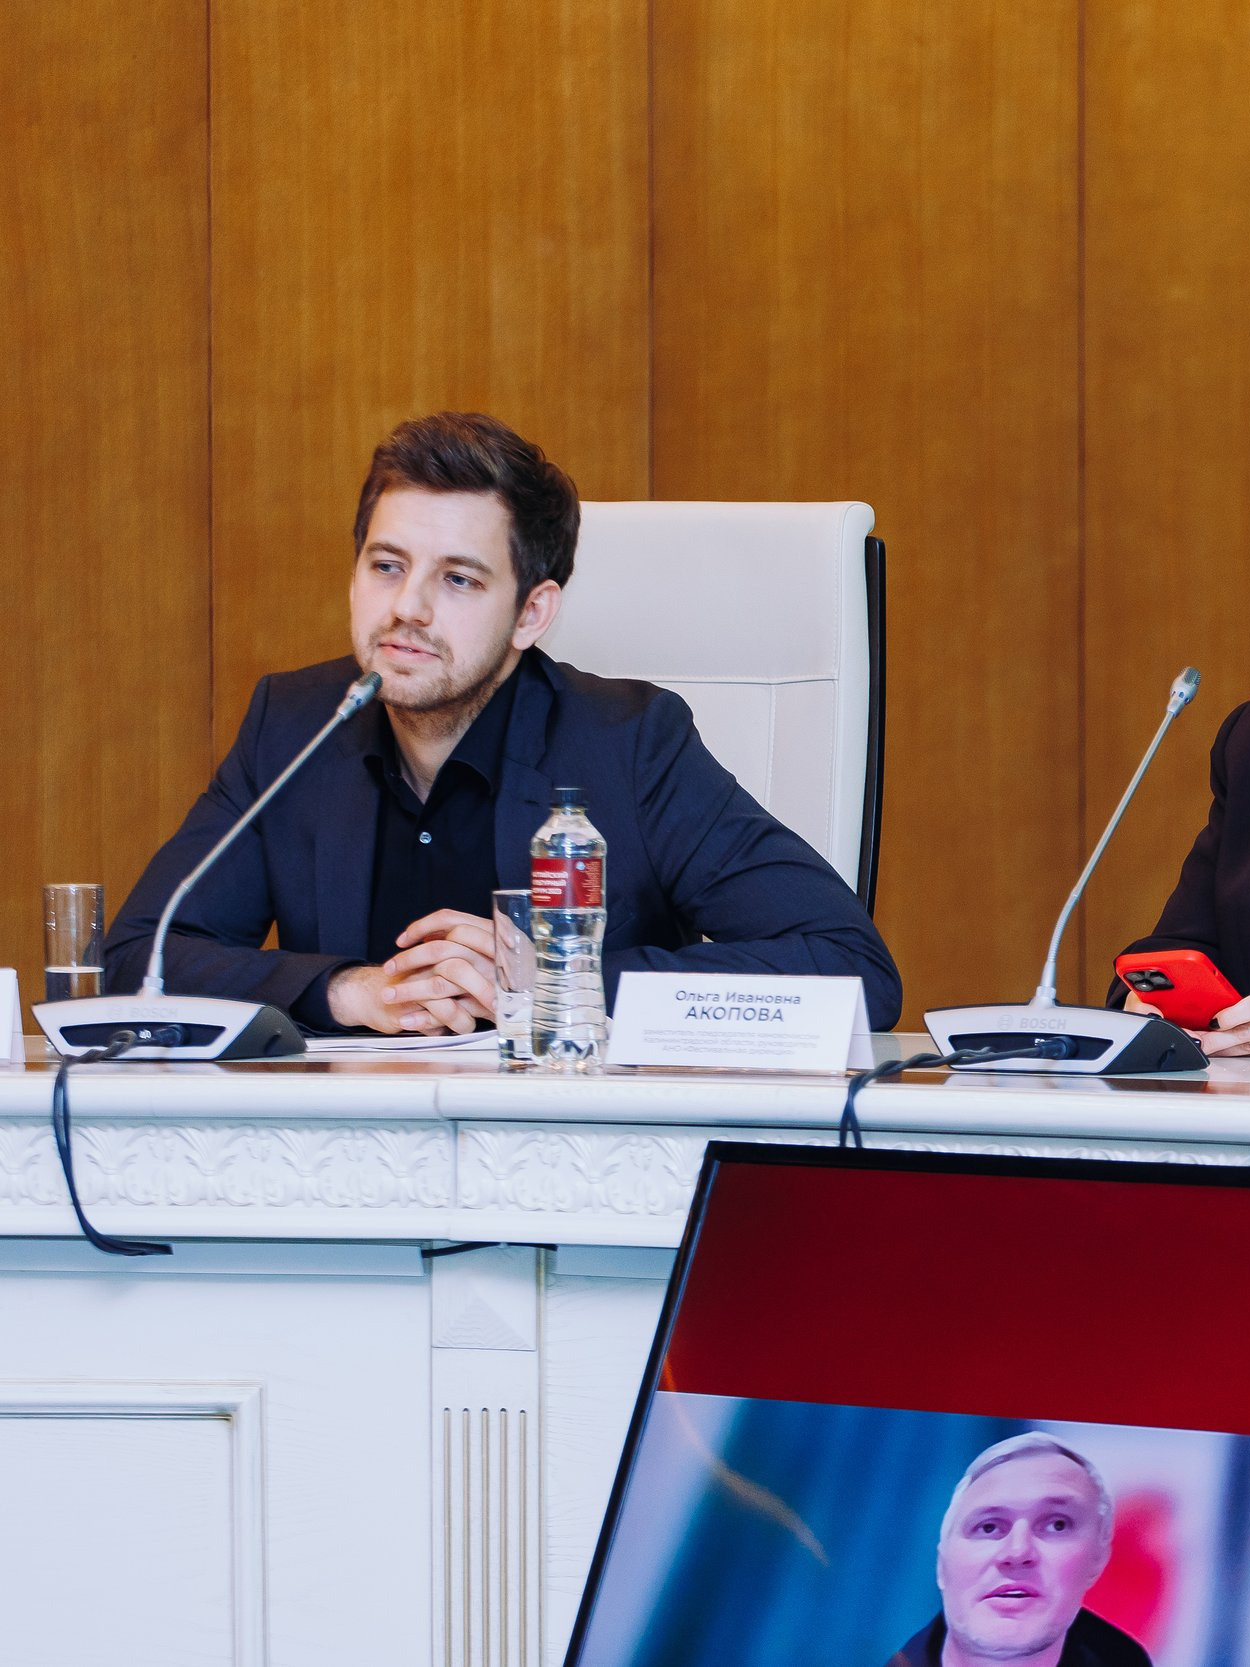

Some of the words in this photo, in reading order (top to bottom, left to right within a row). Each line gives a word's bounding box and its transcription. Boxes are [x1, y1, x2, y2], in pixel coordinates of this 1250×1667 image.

[675, 990, 719, 1004] Ольга
[725, 991, 801, 1005] Ивановна
[685, 1006, 784, 1022] АКОПОВА
[1020, 1017, 1067, 1030] BOSCH
